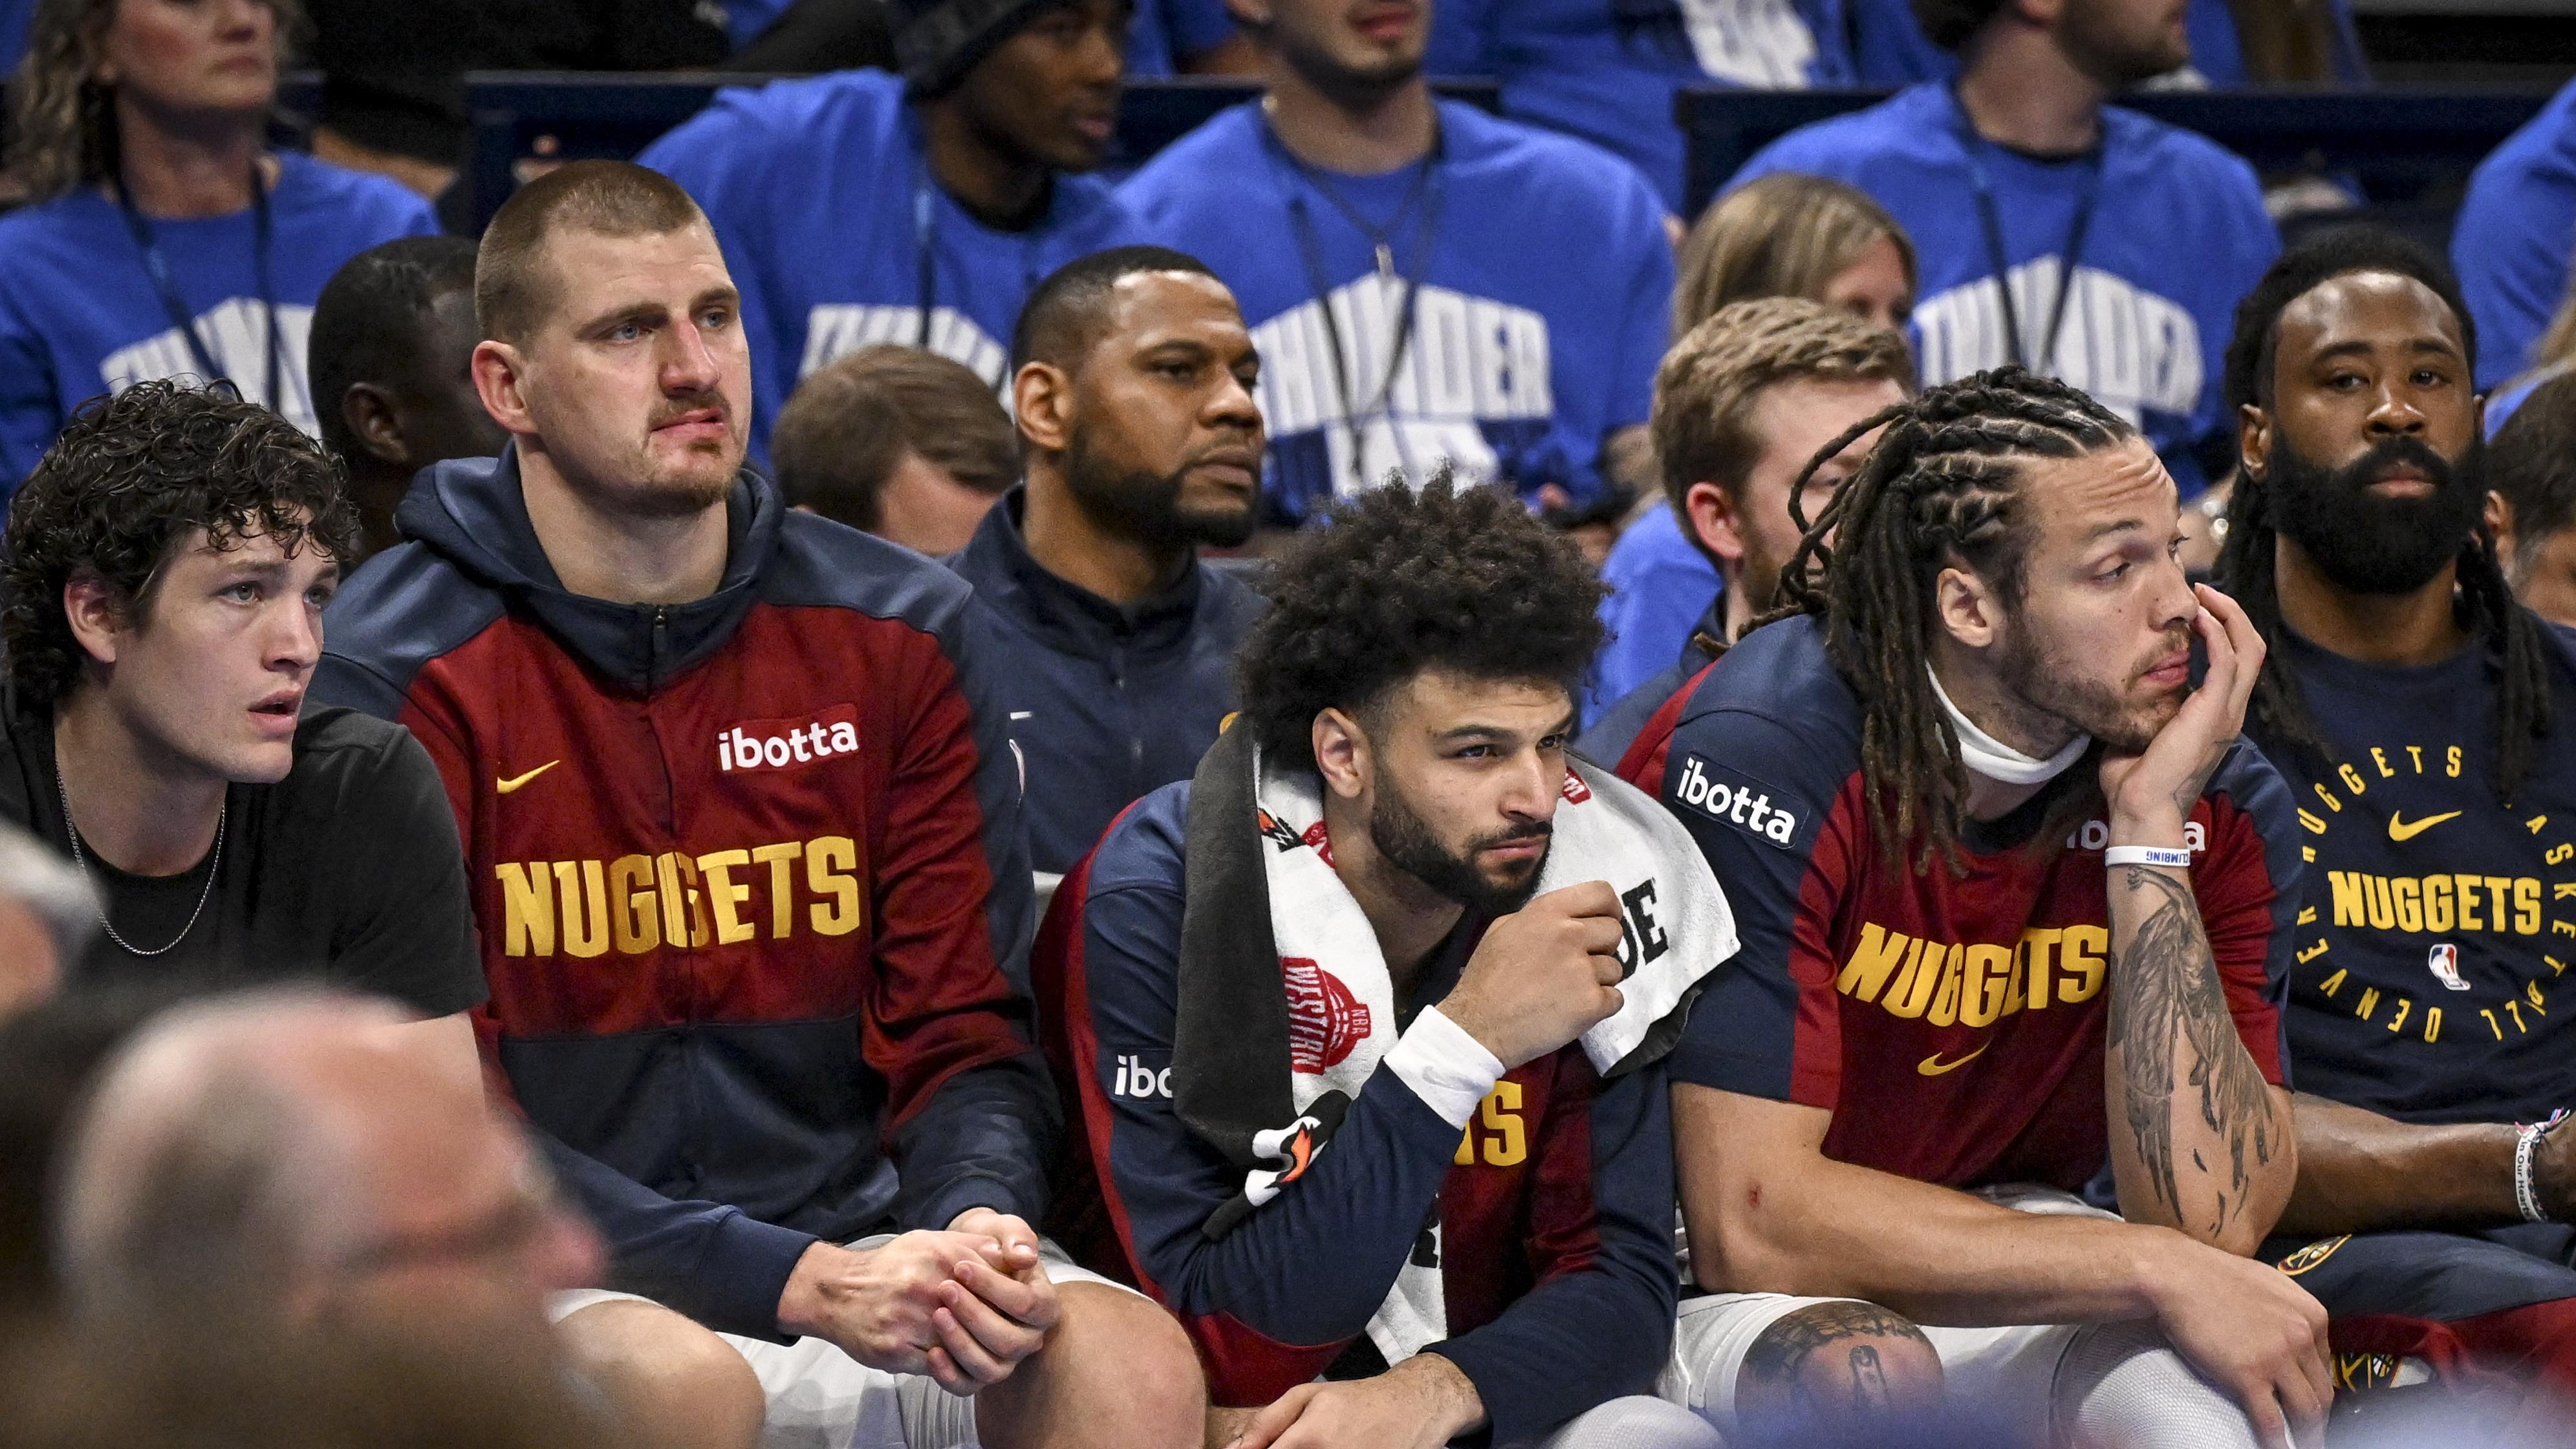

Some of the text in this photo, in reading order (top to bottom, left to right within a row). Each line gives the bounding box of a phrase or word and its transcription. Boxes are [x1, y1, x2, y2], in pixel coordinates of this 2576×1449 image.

[718, 721, 858, 771] ibotta
[1676, 756, 1796, 844] ibotta
[495, 836, 860, 959] NUGGETS
[2328, 870, 2542, 936] NUGGETS
[1351, 1008, 1369, 1034] NBA
[1114, 1054, 1173, 1098] ibo
